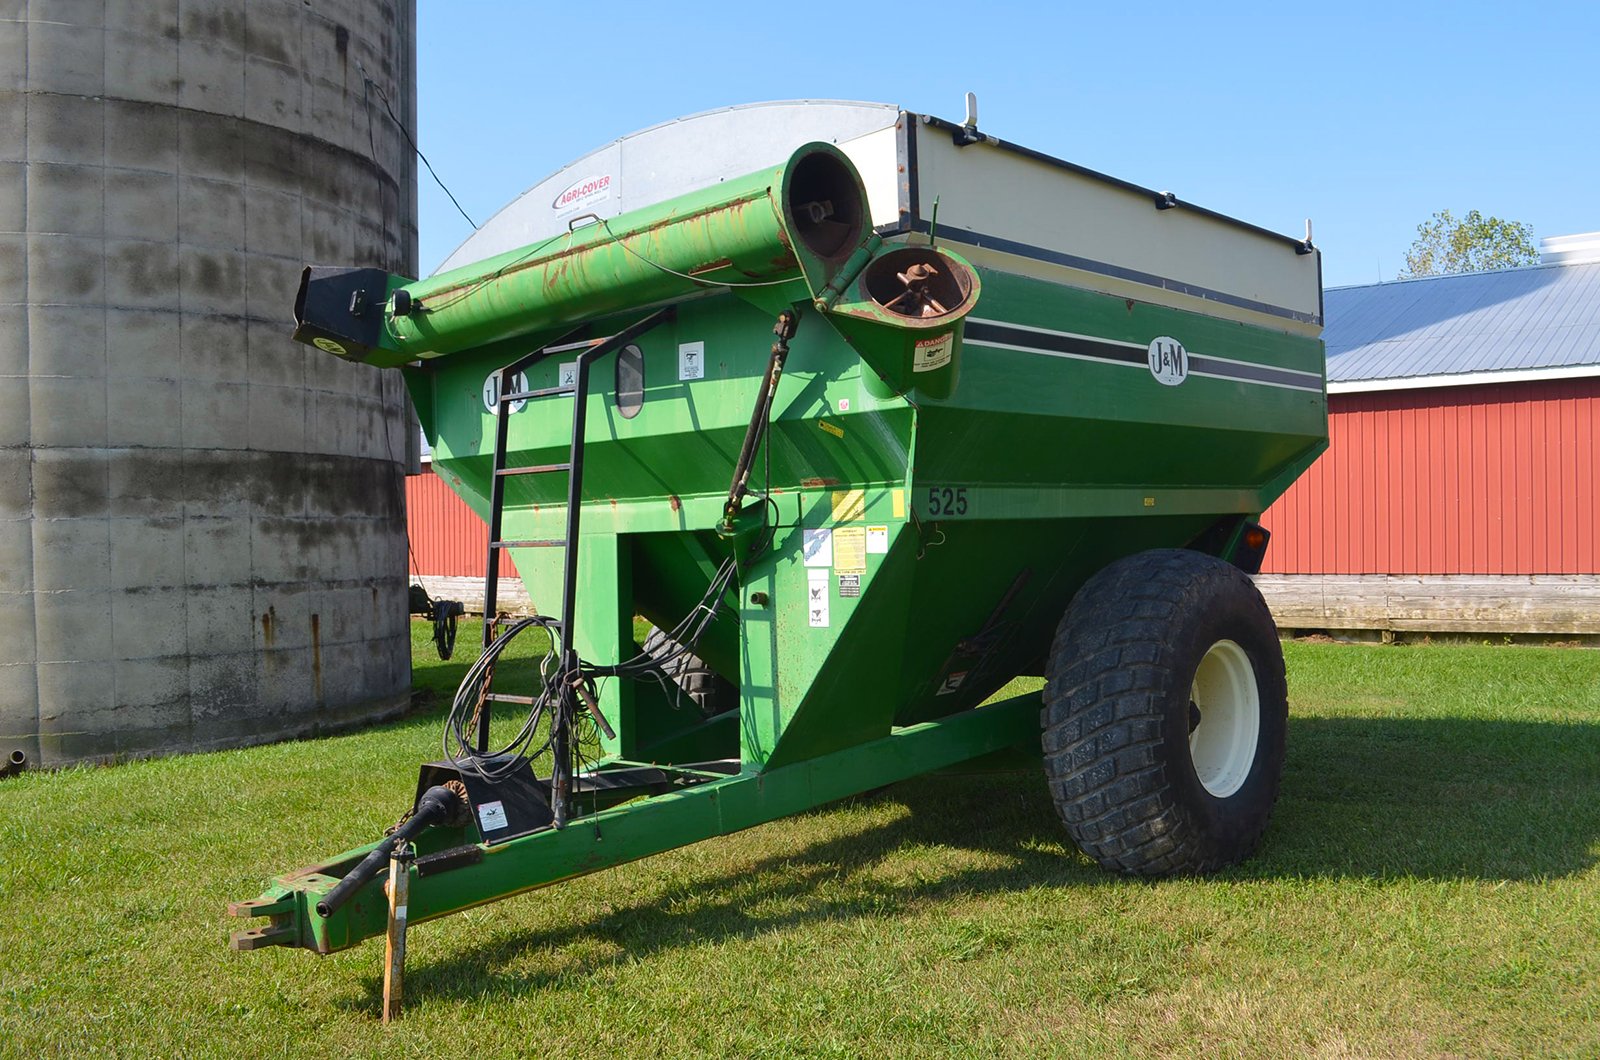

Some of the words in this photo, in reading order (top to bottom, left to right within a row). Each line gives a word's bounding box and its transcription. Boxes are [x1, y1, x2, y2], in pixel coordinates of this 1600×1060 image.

[561, 176, 610, 205] AGRI-COVER
[1151, 342, 1183, 376] J&M
[486, 374, 523, 407] JM
[929, 487, 967, 515] 525
